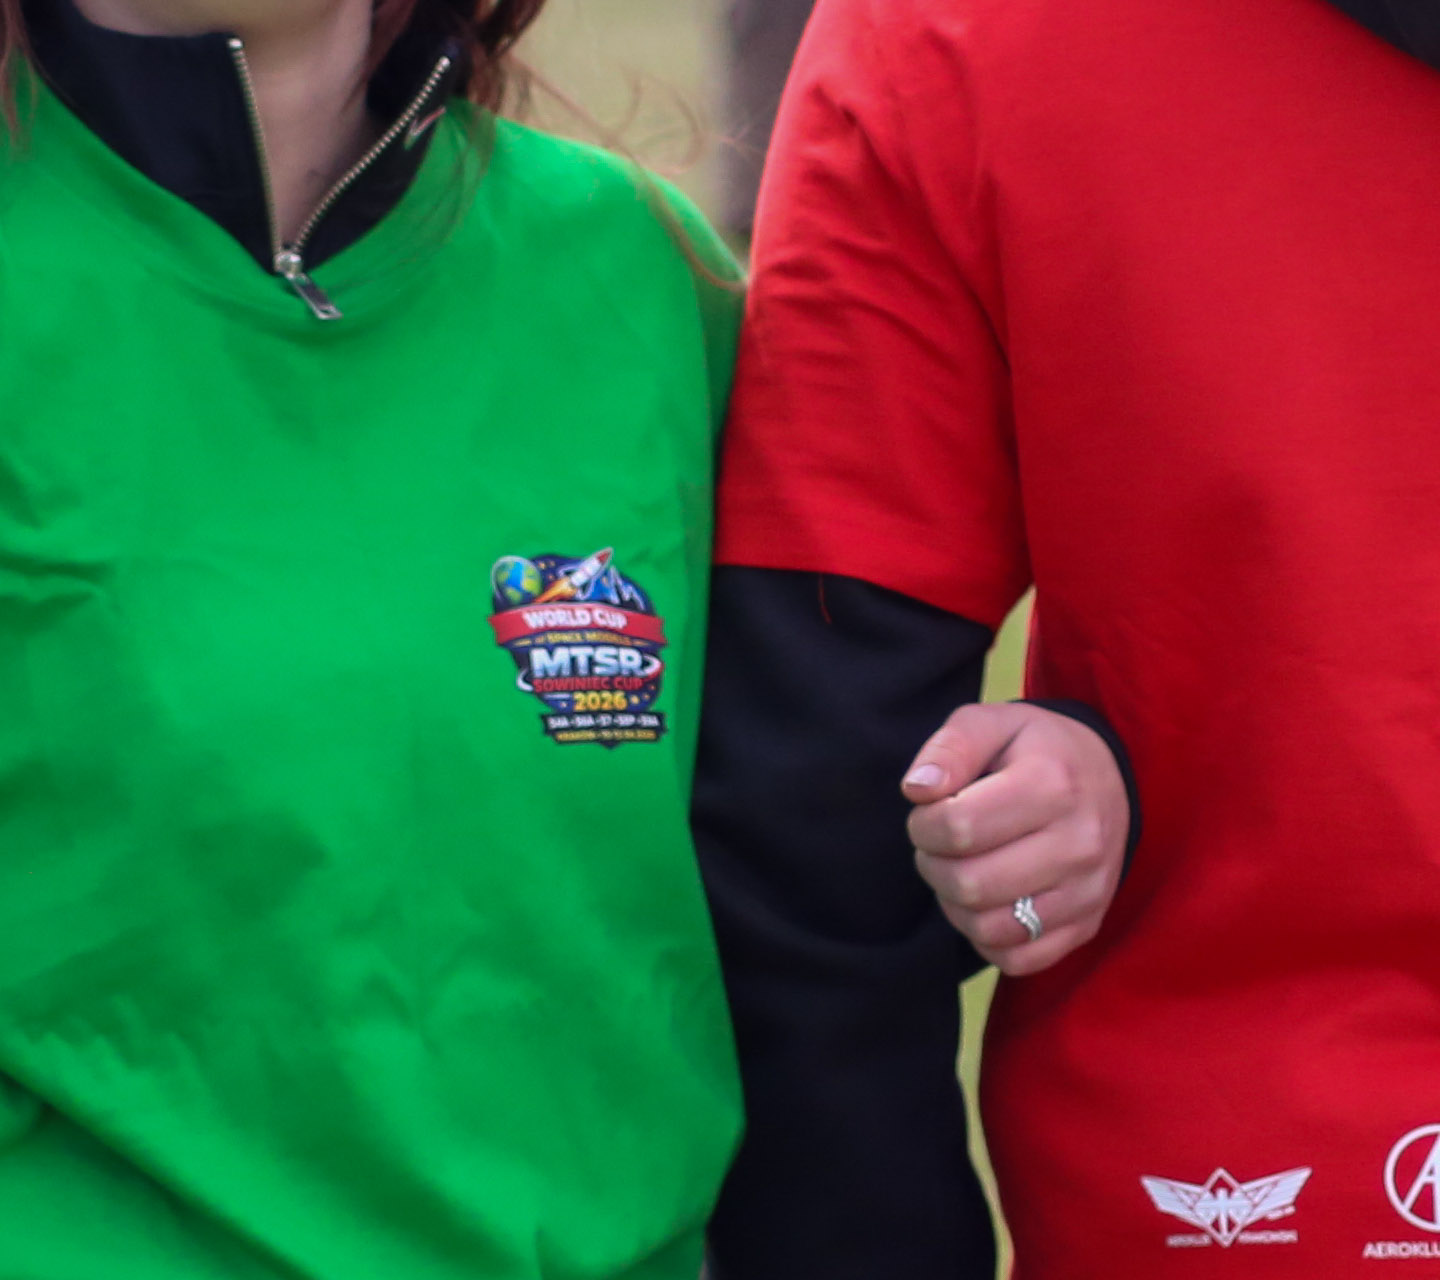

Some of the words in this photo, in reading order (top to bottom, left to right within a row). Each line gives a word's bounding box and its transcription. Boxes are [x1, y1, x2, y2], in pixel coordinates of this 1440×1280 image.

[522, 608, 591, 629] WORLD
[593, 608, 627, 630] CUP
[530, 646, 644, 677] MTSR
[613, 675, 644, 691] CUP
[573, 690, 628, 712] 2026
